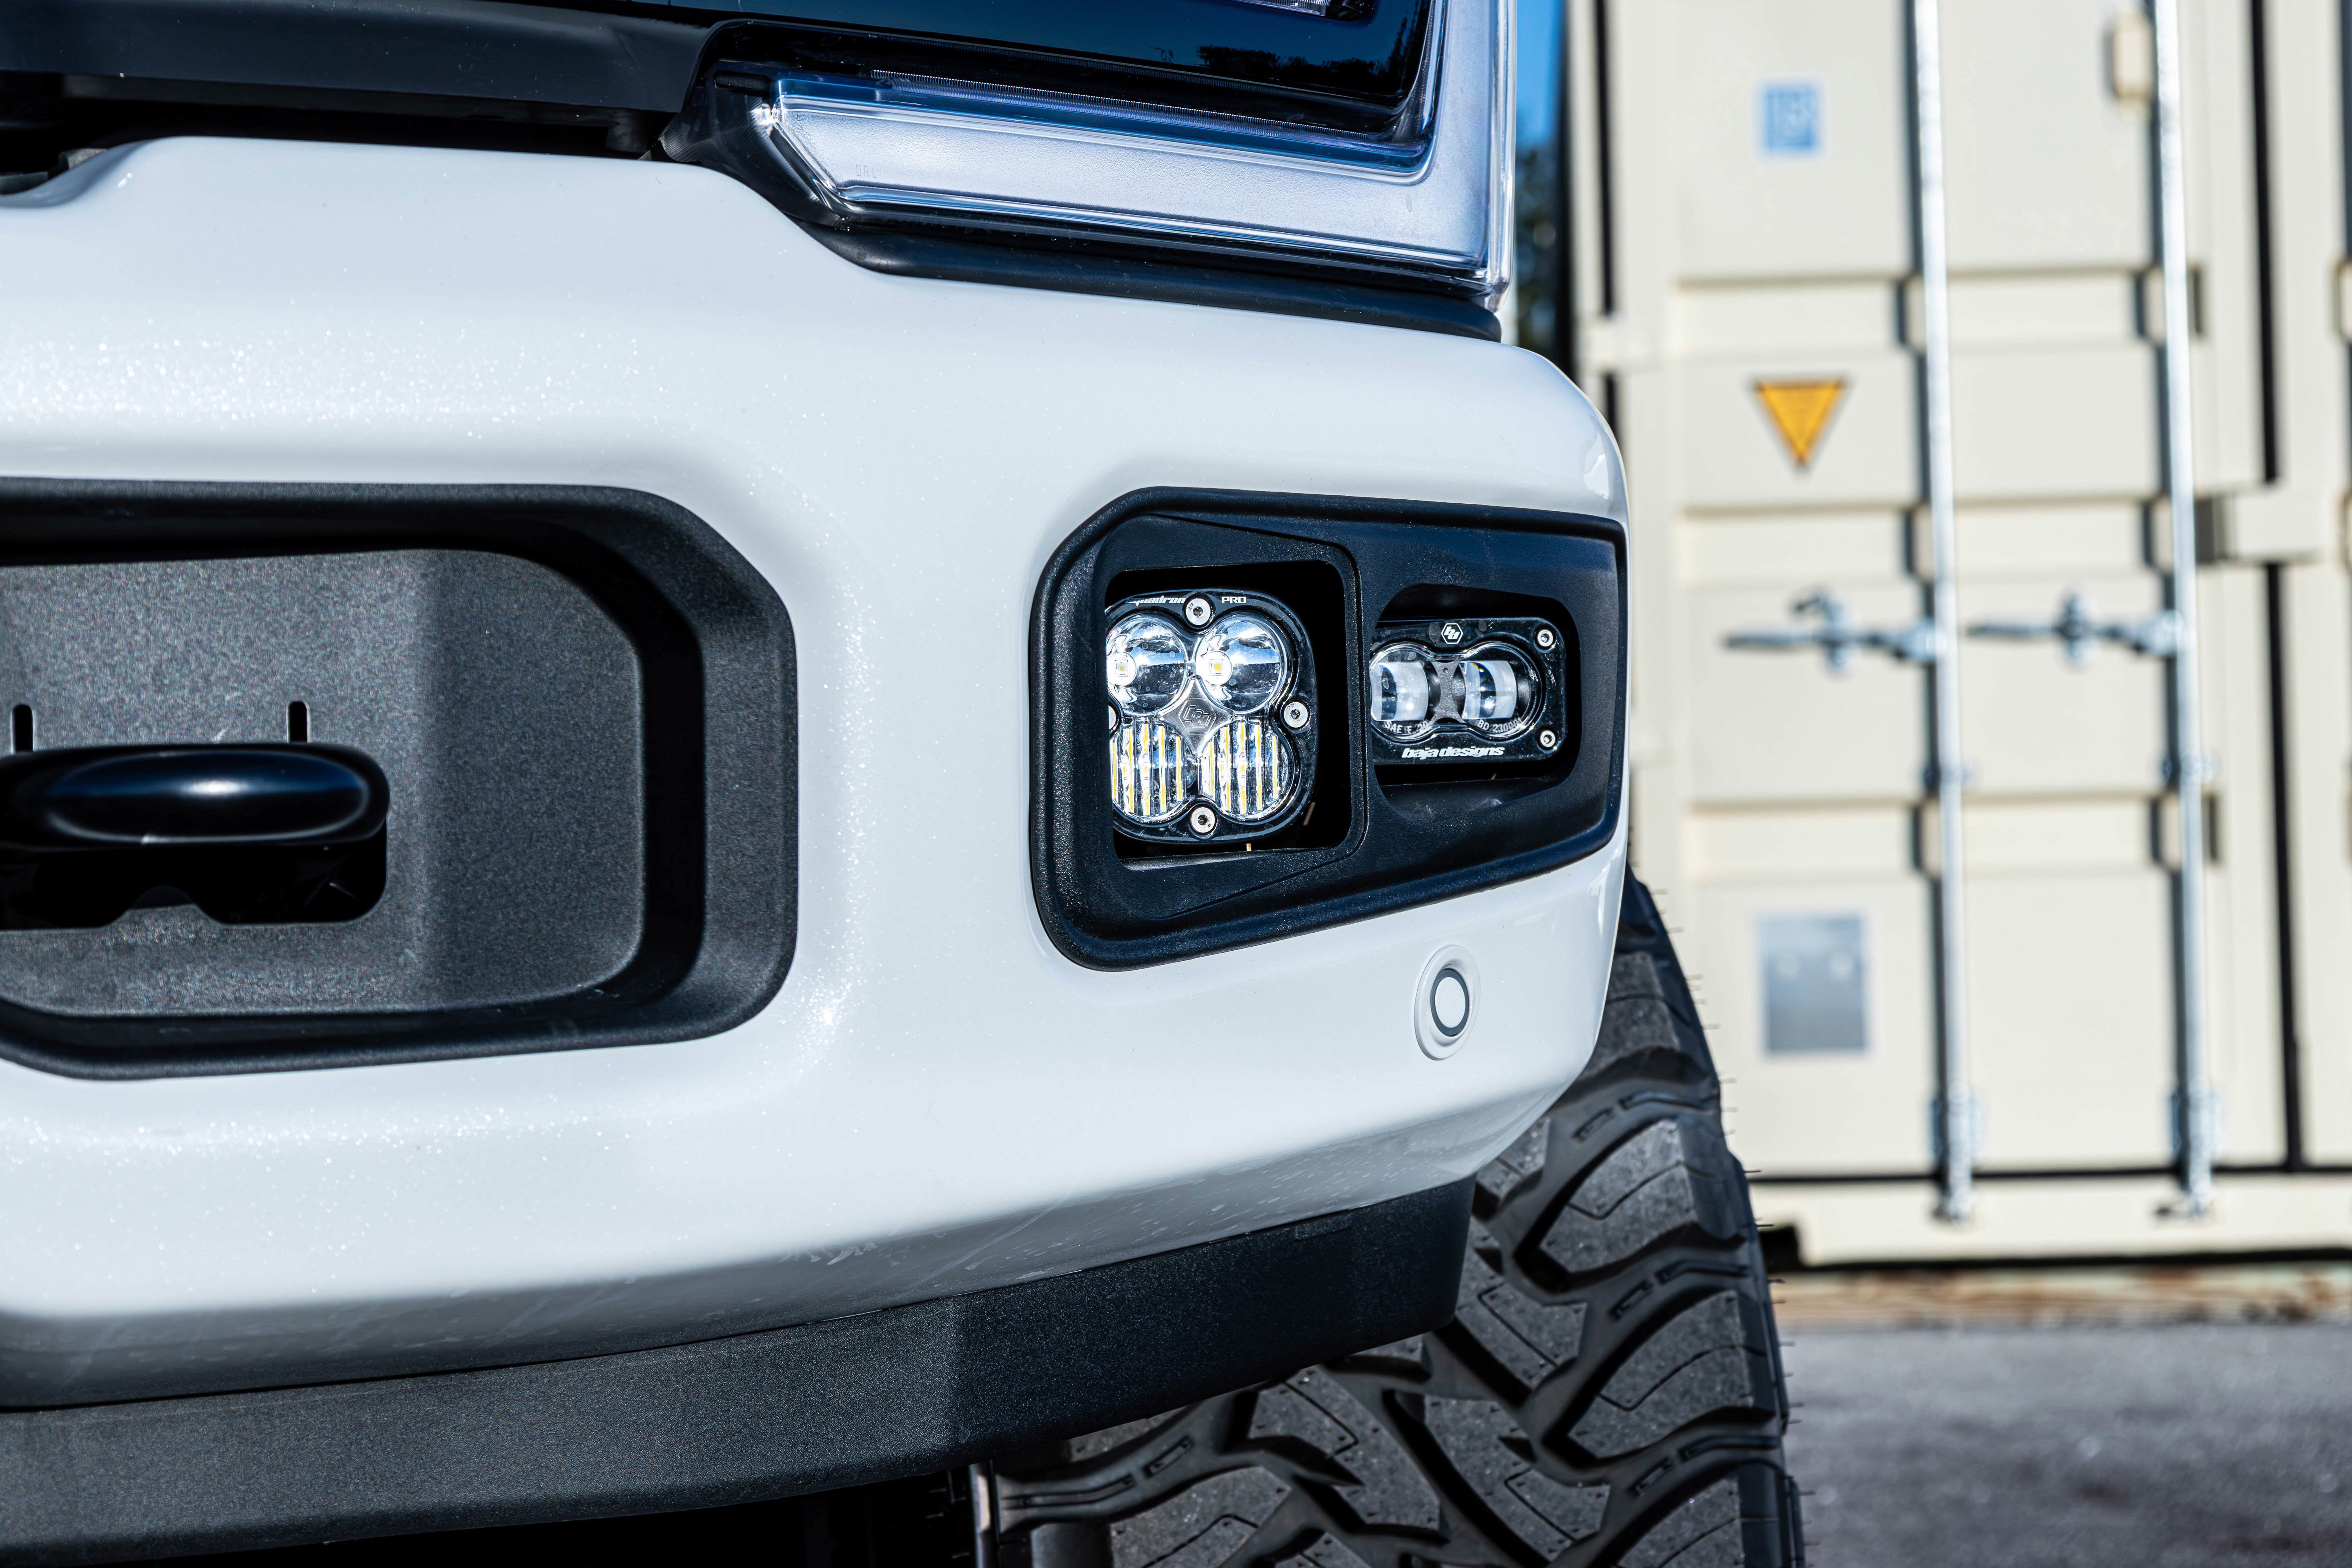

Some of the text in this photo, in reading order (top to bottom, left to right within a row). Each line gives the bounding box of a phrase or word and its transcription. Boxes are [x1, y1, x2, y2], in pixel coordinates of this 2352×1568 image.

[1383, 720, 1403, 733] SAE
[1477, 719, 1490, 731] BD
[1401, 746, 1505, 760] baja designs
